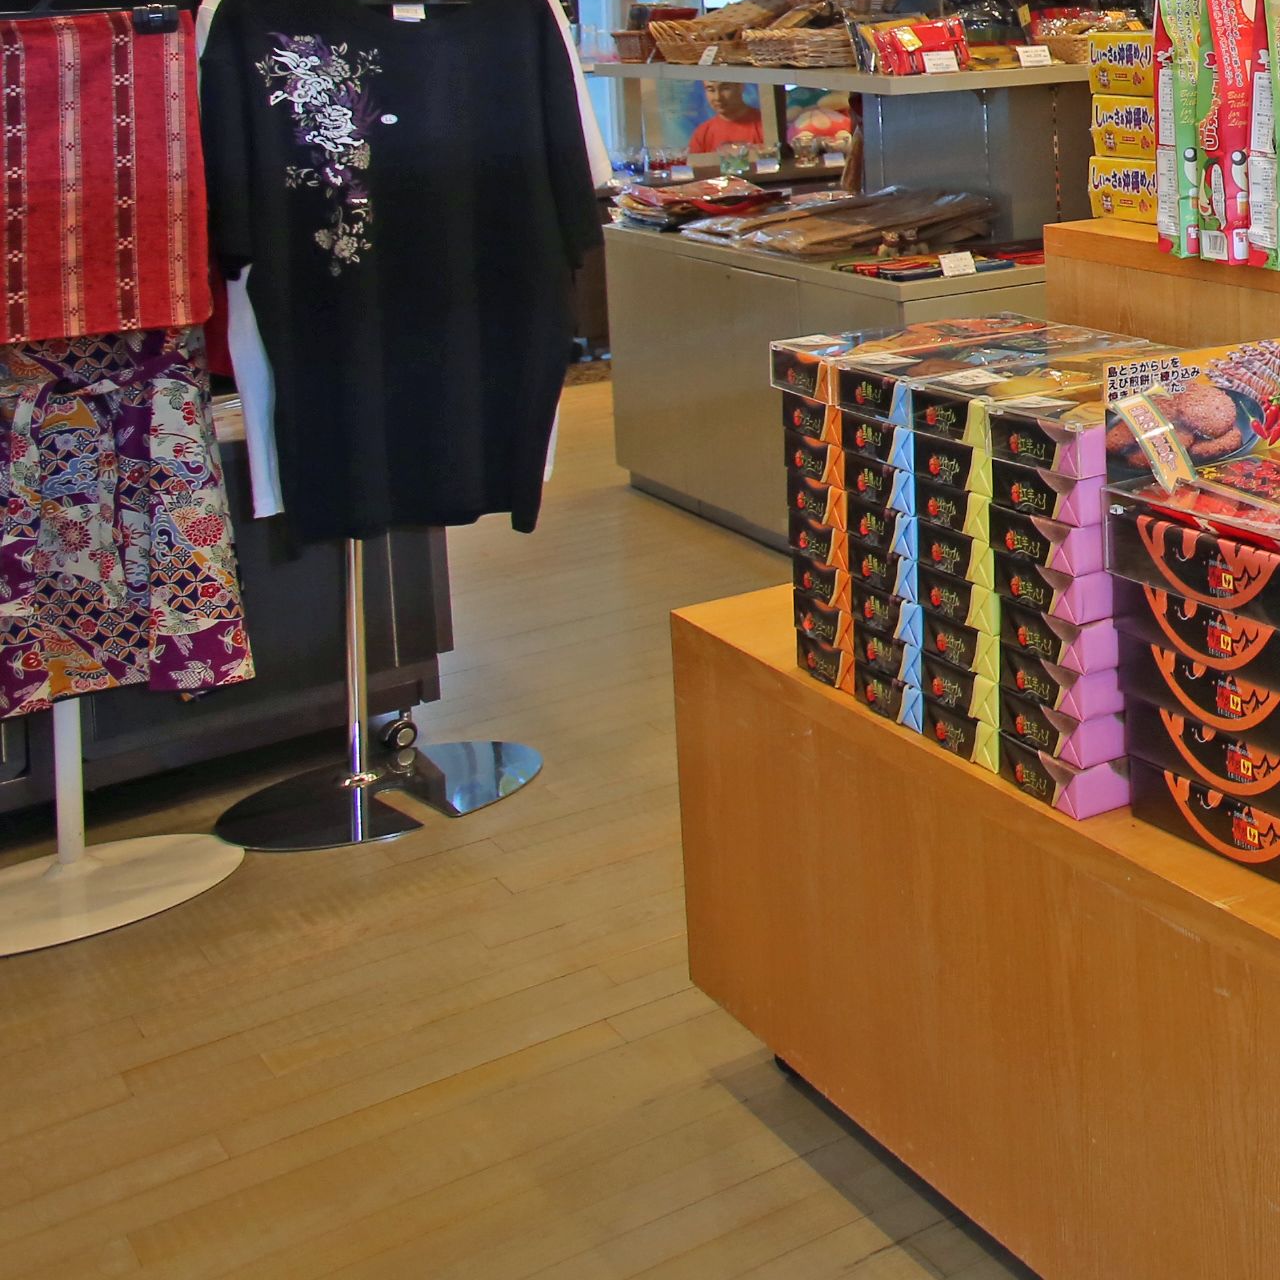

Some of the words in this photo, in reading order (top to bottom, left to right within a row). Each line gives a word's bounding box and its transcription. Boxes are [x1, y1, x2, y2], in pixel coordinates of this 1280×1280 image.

[1107, 357, 1180, 378] 島とうがらしを
[1108, 368, 1200, 391] えび煎餅に練り込み
